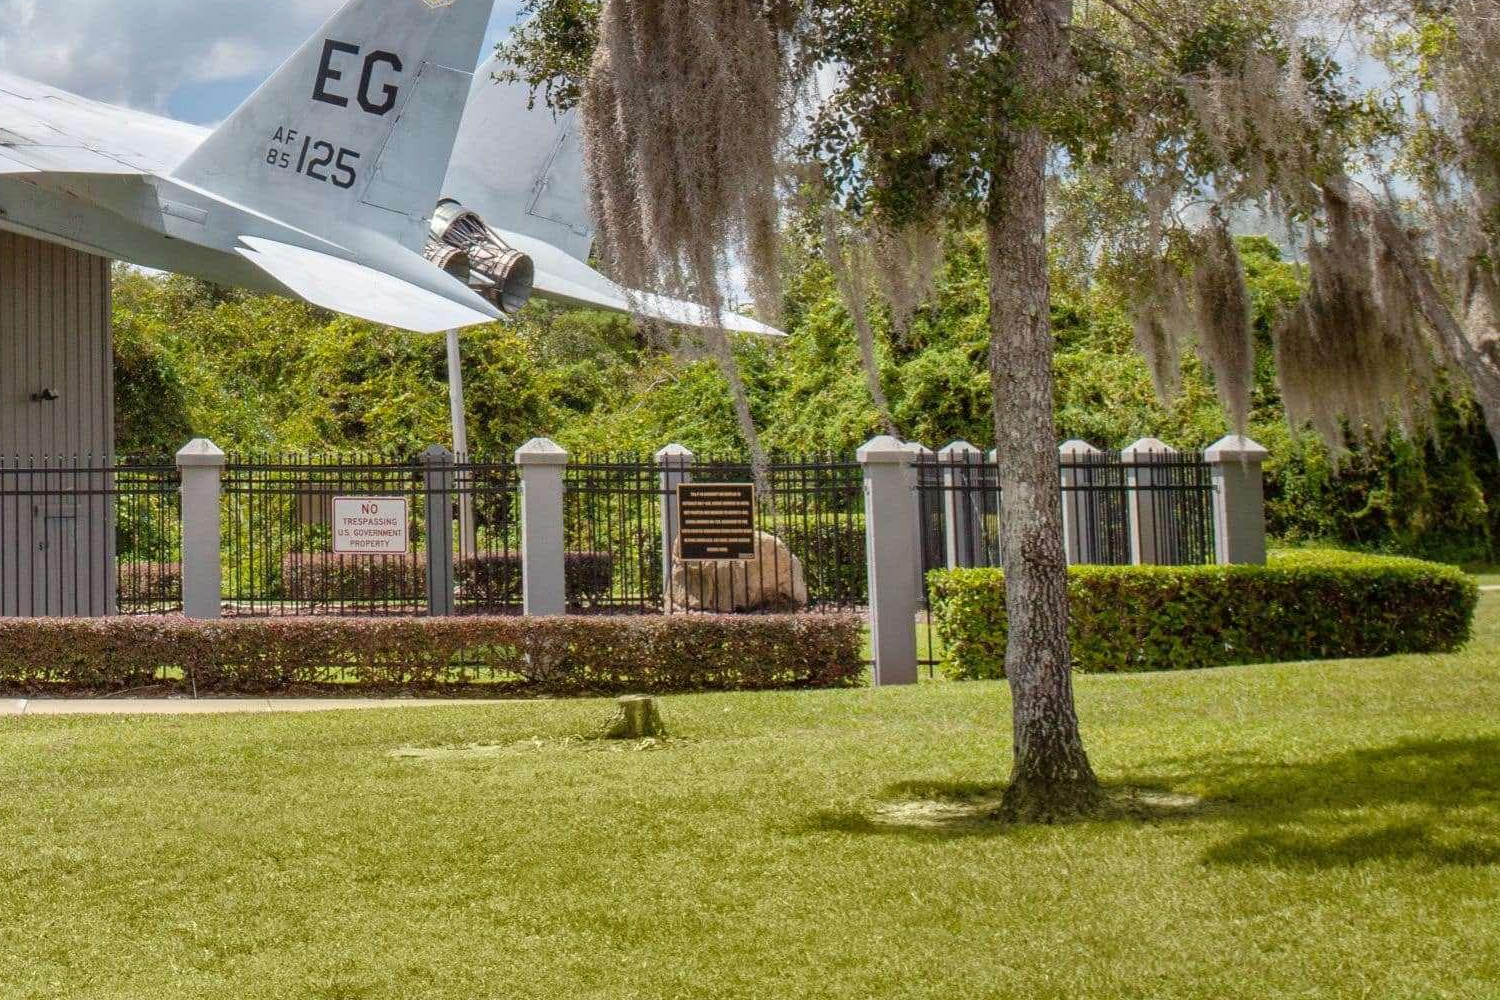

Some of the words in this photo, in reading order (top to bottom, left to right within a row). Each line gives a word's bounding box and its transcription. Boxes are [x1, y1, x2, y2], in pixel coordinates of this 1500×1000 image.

[312, 38, 403, 116] EG
[272, 126, 298, 146] AF
[266, 148, 291, 169] 85
[296, 135, 361, 190] 125
[361, 504, 378, 514] NO
[343, 518, 398, 526] TRESPASSING
[350, 540, 390, 548] PROPERTY
